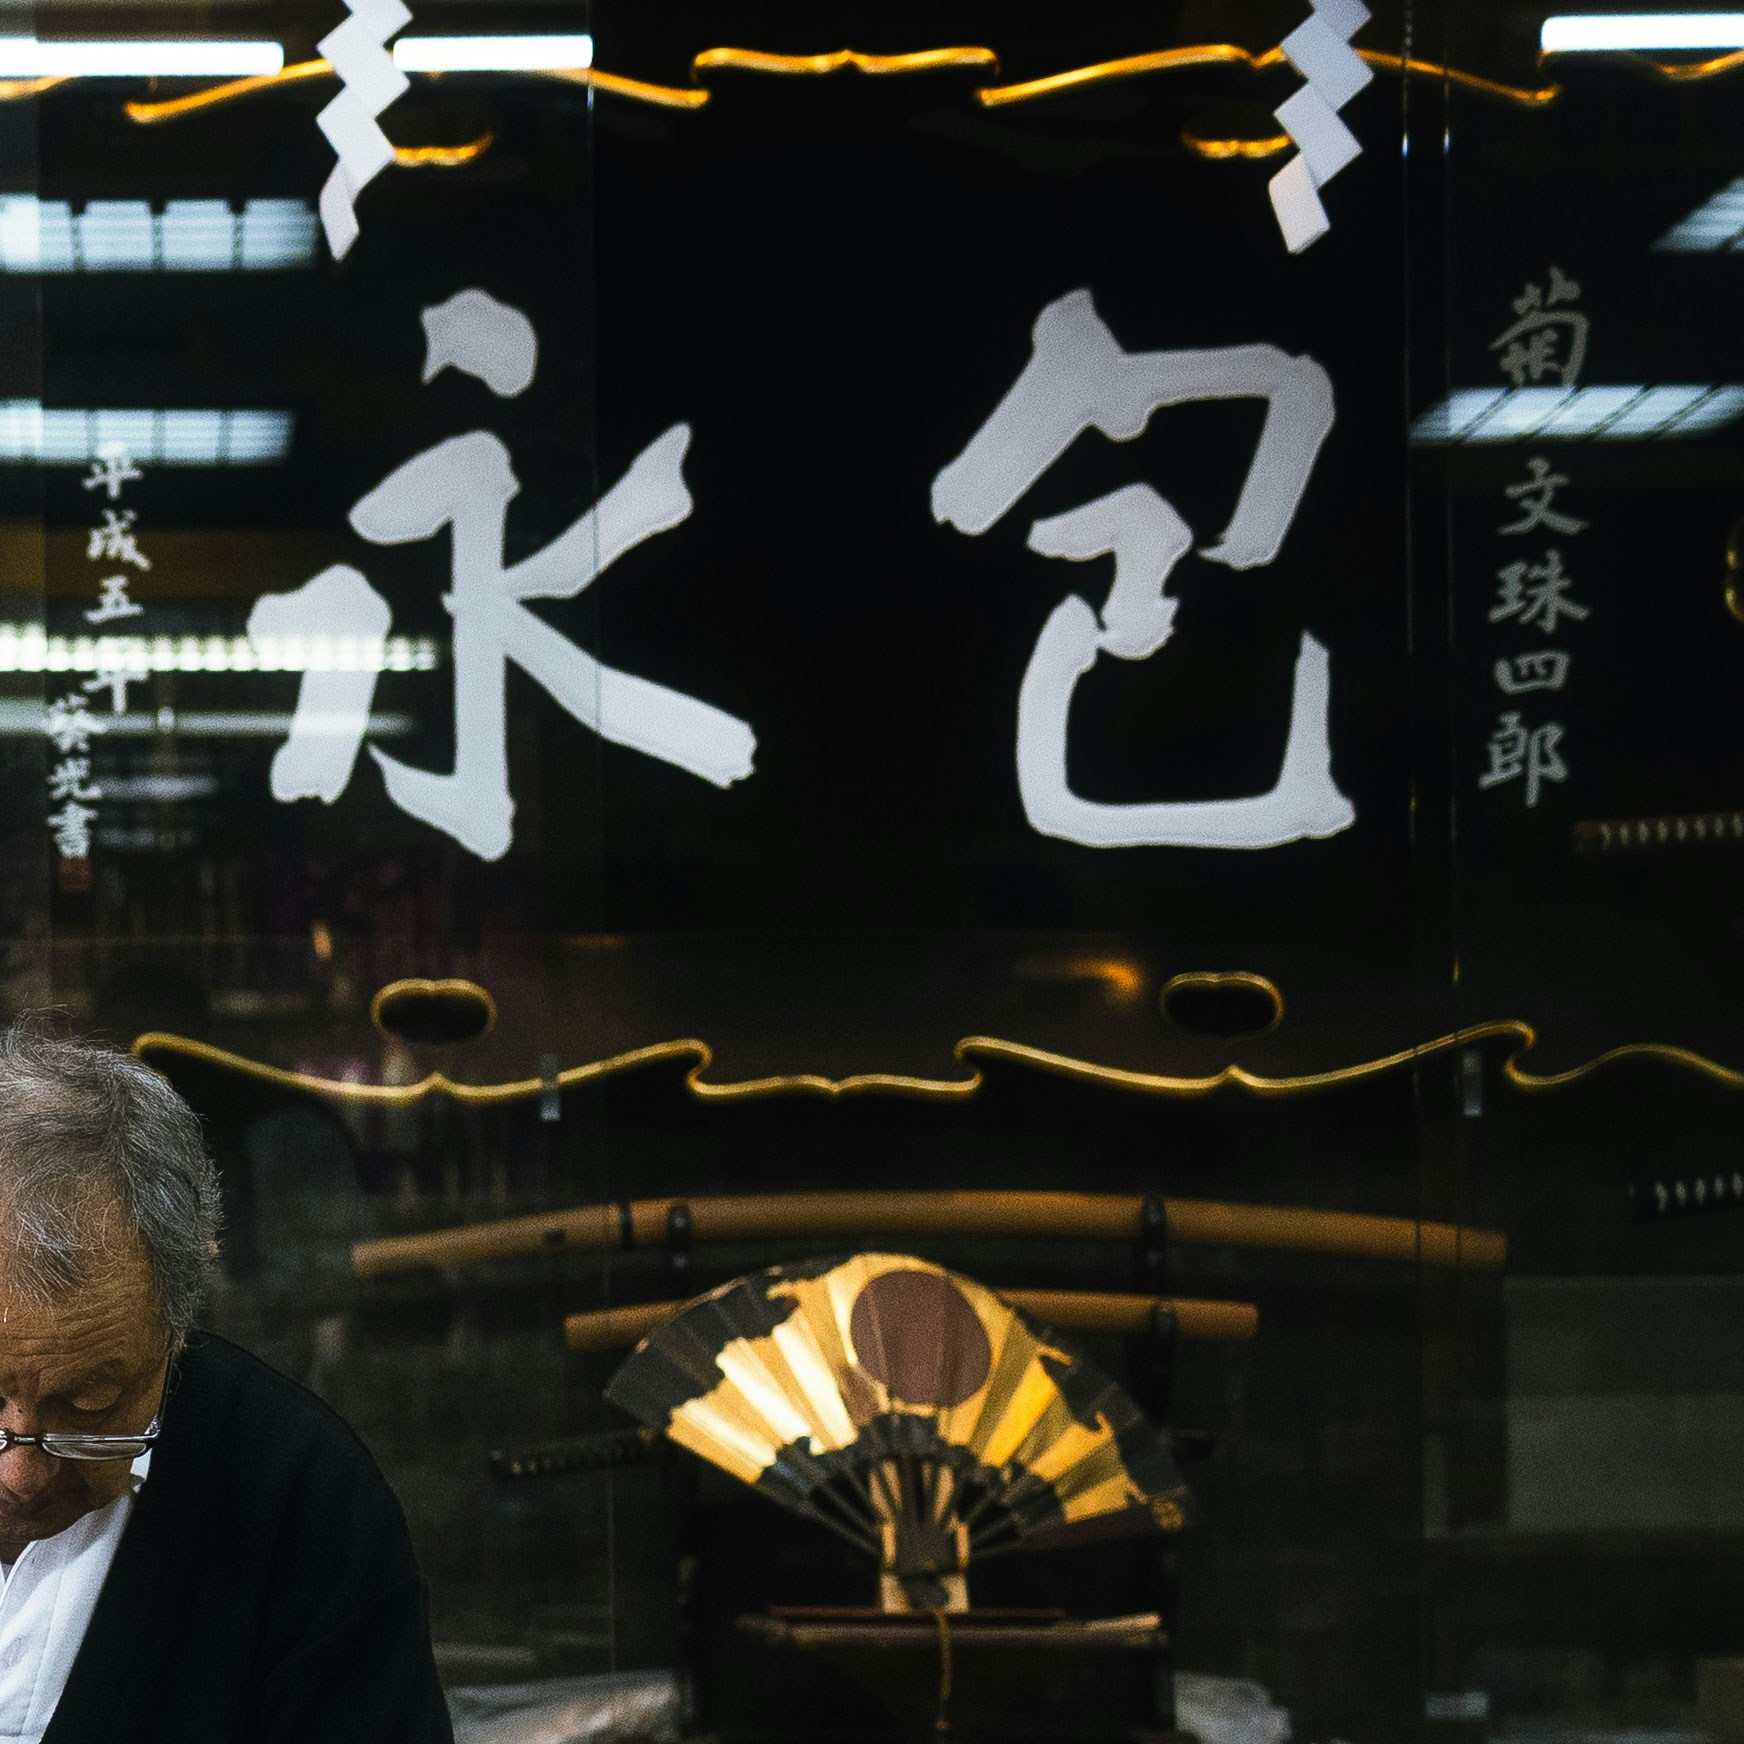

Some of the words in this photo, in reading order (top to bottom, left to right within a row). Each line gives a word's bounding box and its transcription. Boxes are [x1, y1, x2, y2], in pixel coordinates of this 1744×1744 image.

[1478, 267, 1591, 808] 菊文珠四郎
